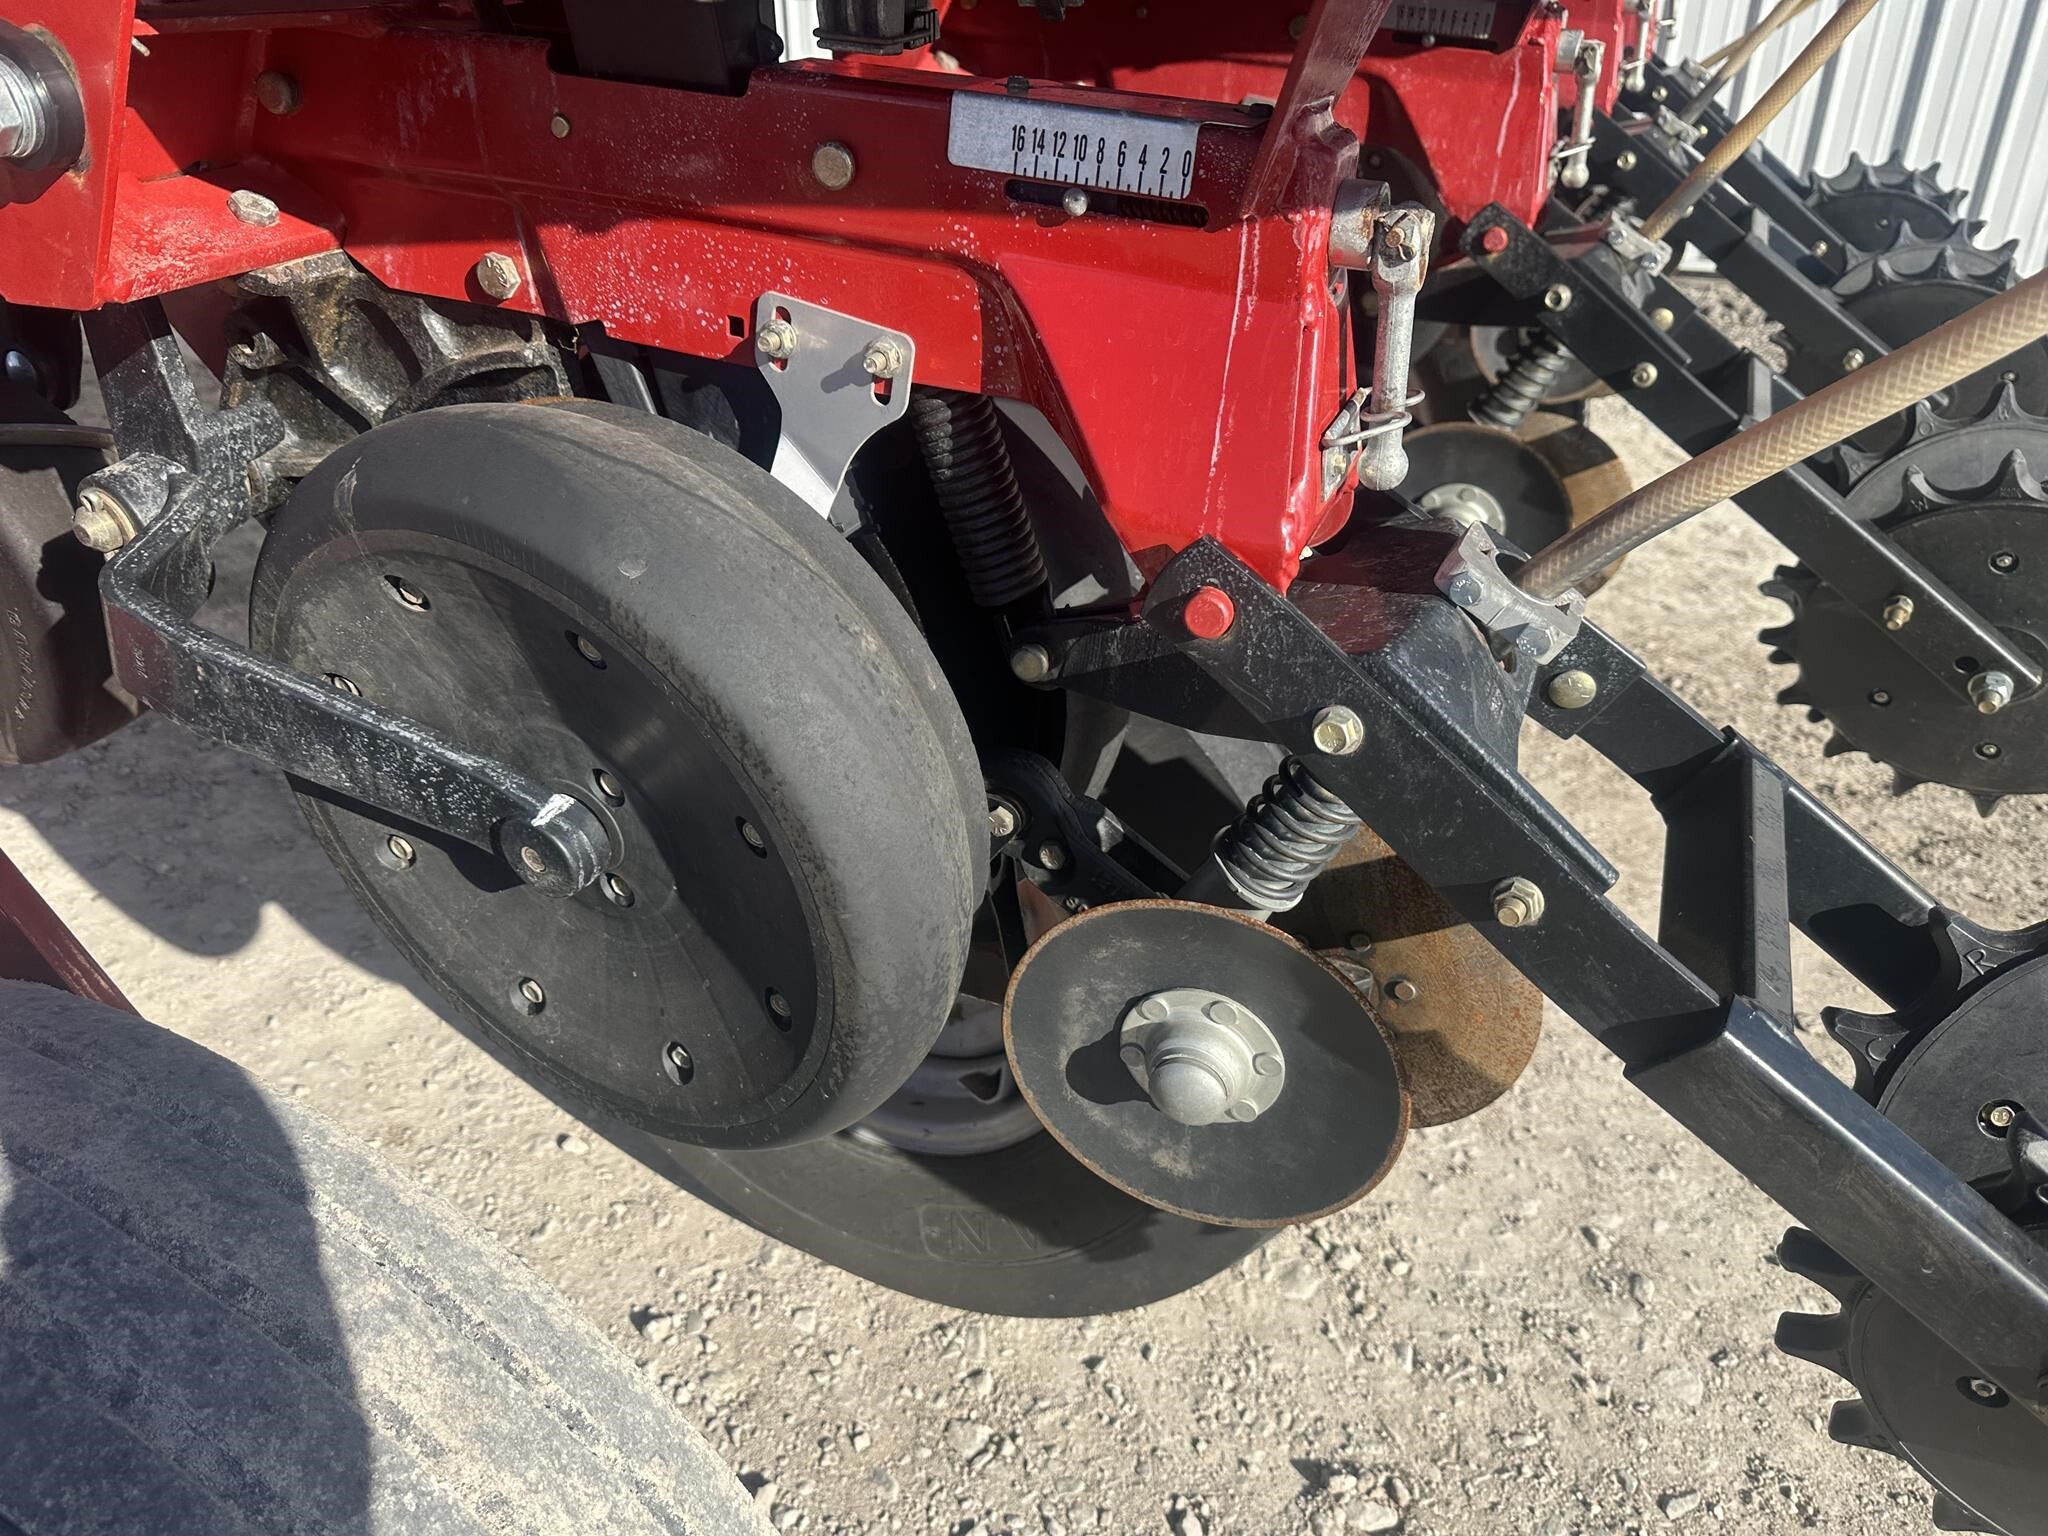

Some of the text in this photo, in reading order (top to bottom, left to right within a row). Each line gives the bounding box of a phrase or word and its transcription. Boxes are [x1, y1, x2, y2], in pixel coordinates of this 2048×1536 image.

[1012, 125, 1192, 178] 16 14 12 10 8 6 4 2 0
[1964, 949, 1998, 975] R
